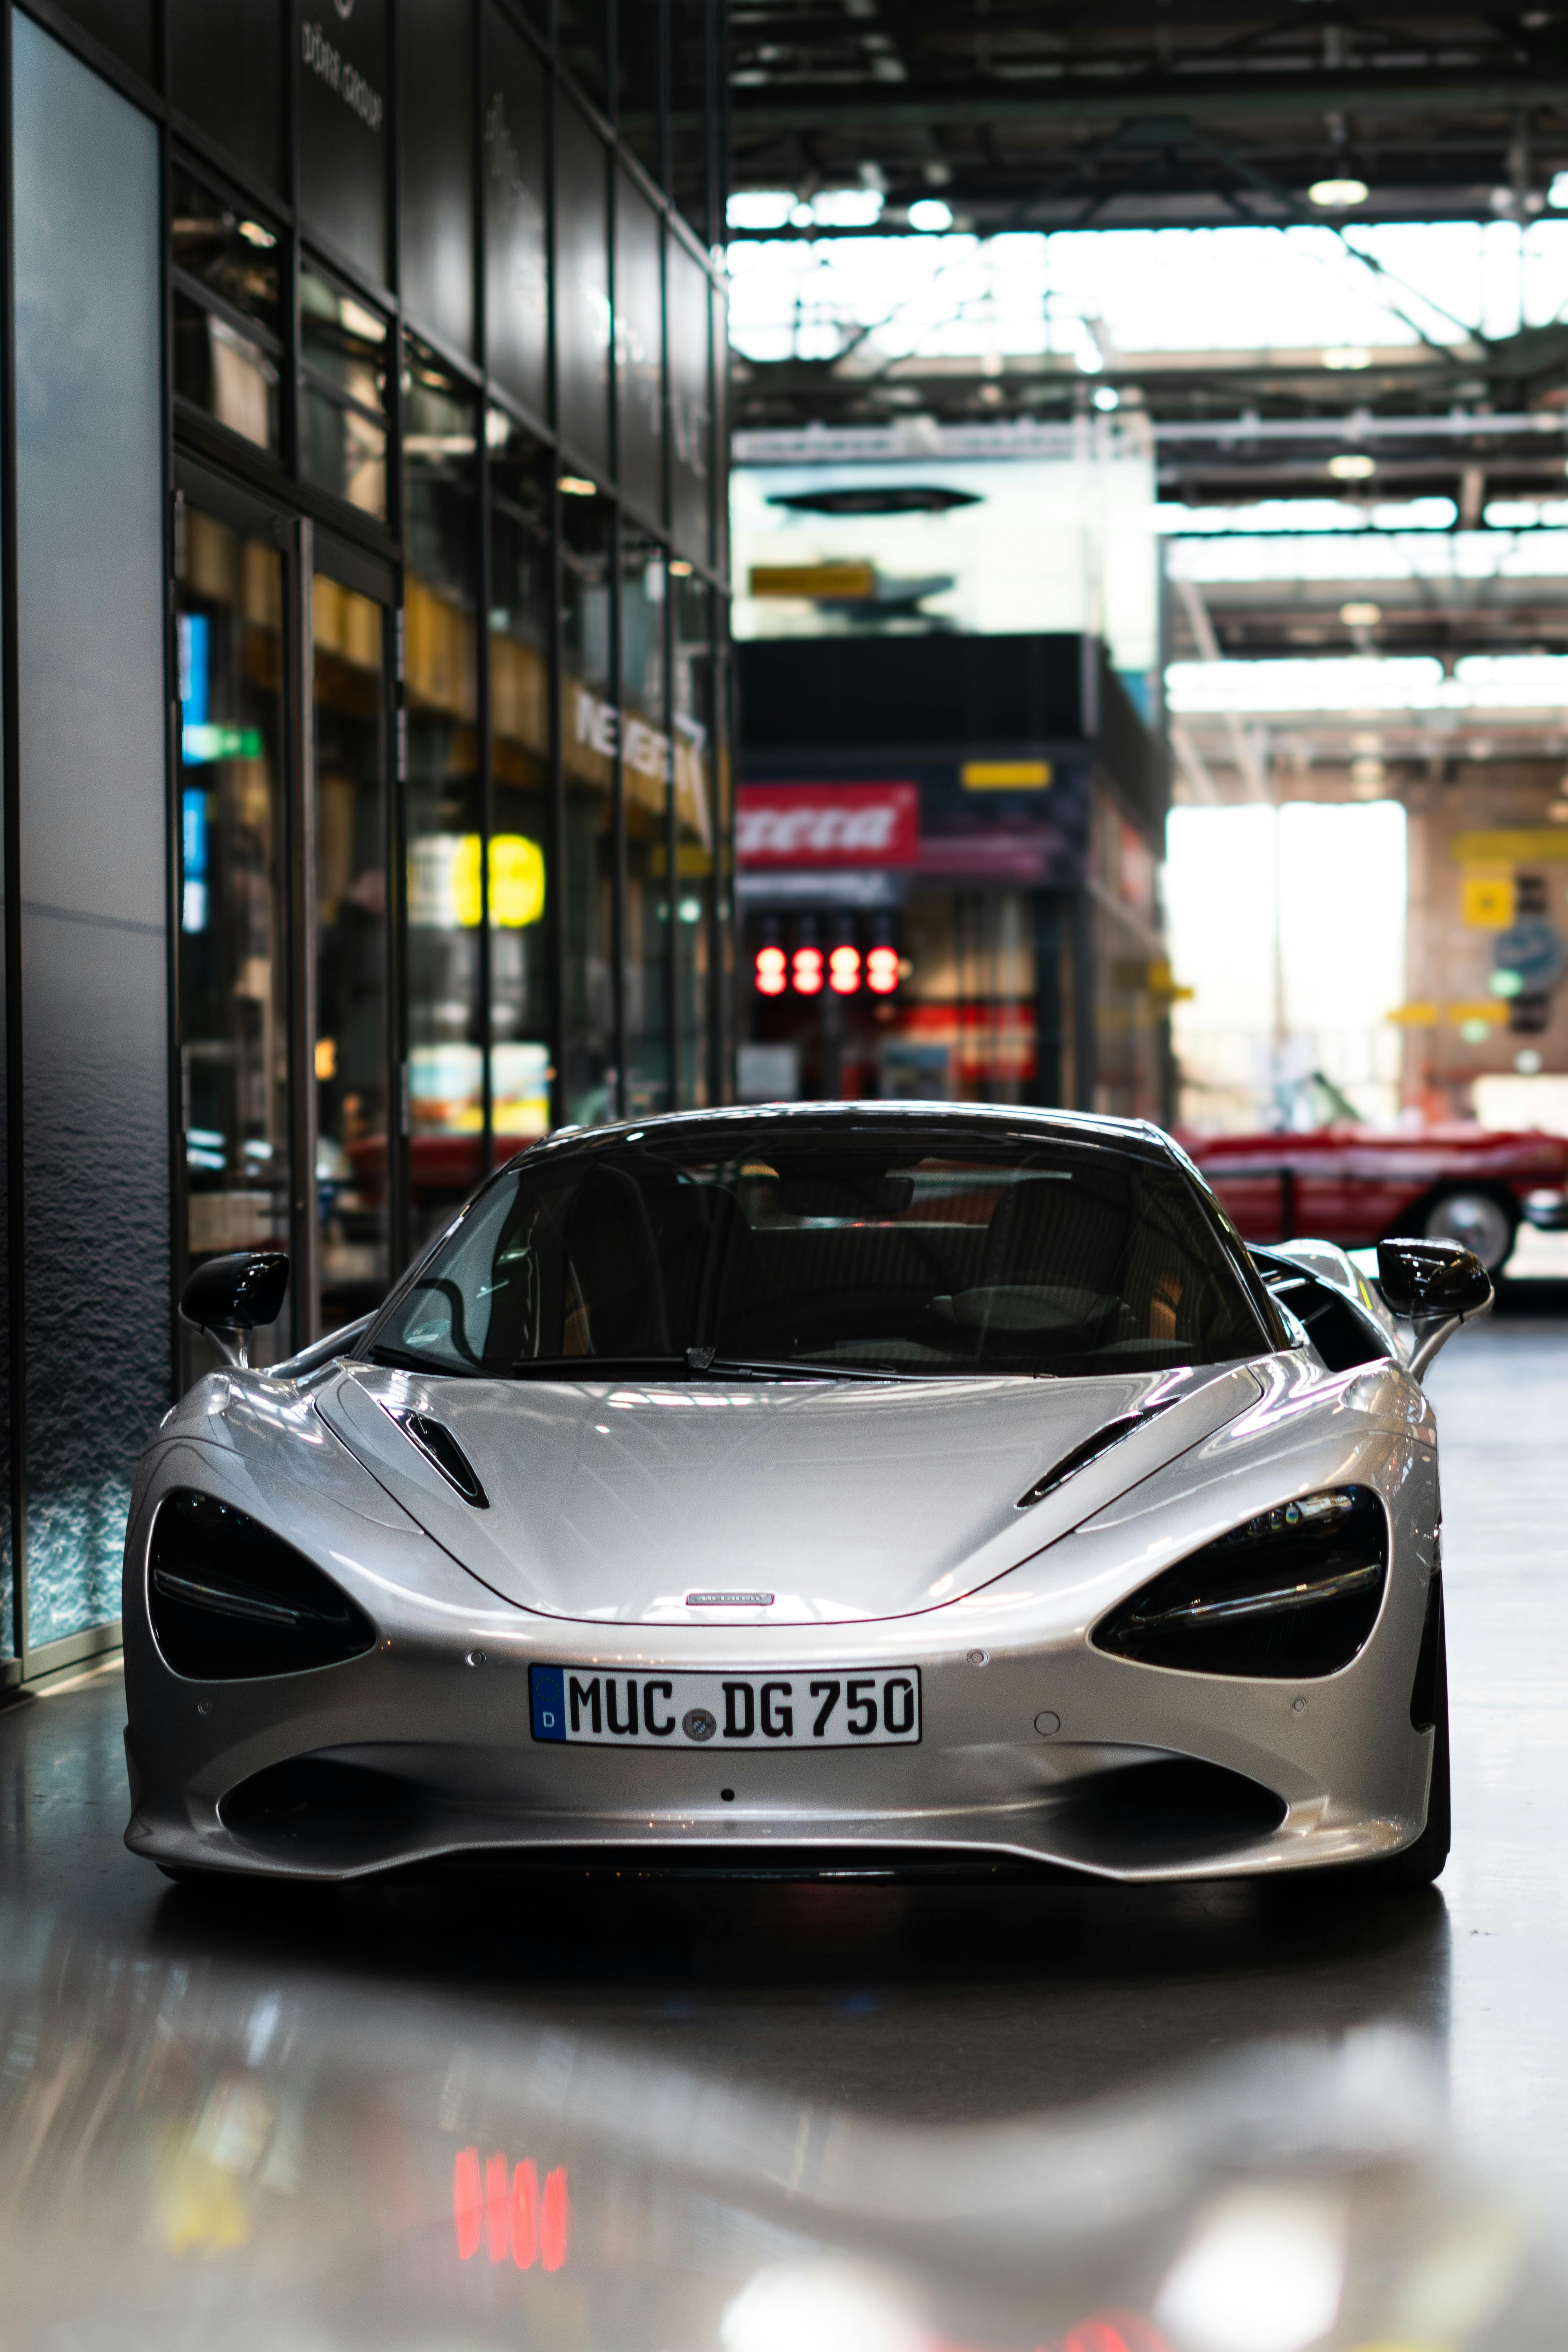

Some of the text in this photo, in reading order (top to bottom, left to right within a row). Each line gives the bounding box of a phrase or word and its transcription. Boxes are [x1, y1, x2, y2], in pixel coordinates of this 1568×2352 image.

[543, 1711, 555, 1728] D
[569, 1676, 676, 1736] MUC
[722, 1681, 793, 1737] DG
[810, 1678, 914, 1737] 750
